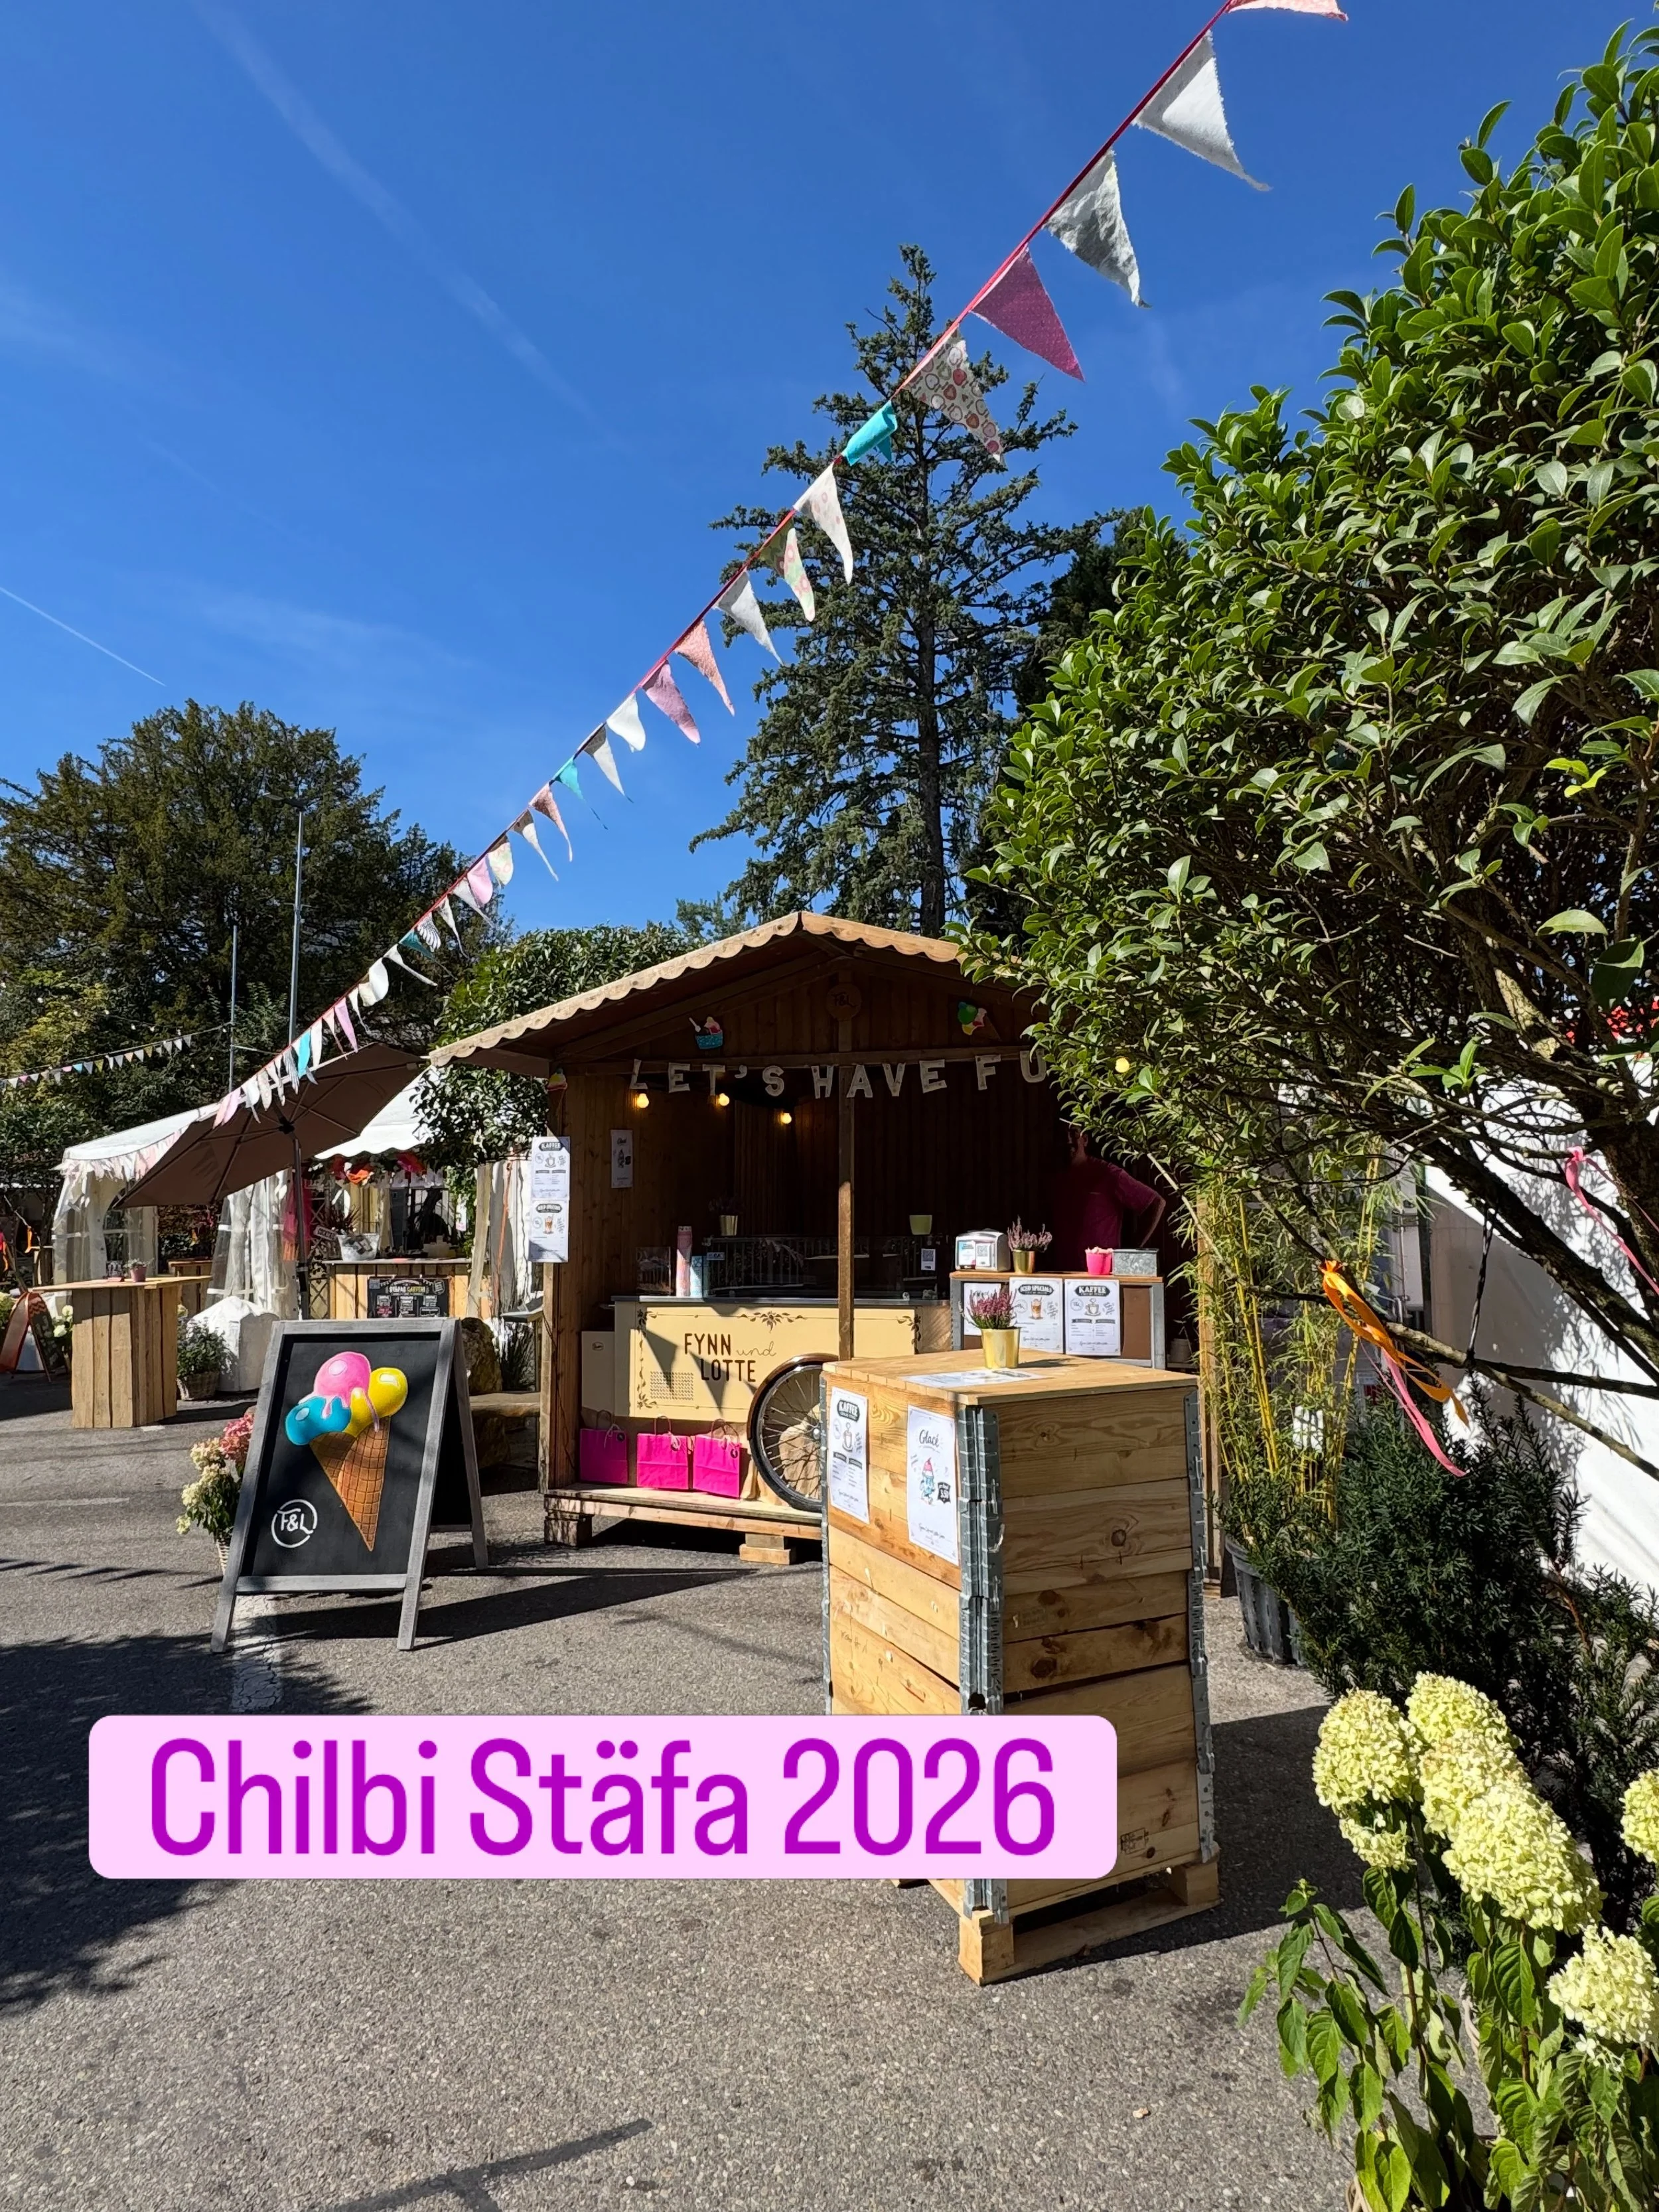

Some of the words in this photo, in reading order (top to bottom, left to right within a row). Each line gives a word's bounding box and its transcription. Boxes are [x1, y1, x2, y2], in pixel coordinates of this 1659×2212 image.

[811, 1059, 947, 1099] HAVE
[975, 1049, 1048, 1090] FU
[1078, 1286, 1107, 1294] KAFFEE
[684, 1333, 731, 1356] FYNN
[736, 1341, 777, 1357] und
[700, 1358, 757, 1382] LOTTE
[838, 1400, 859, 1416] KAFFEE
[919, 1429, 940, 1447] Glacé
